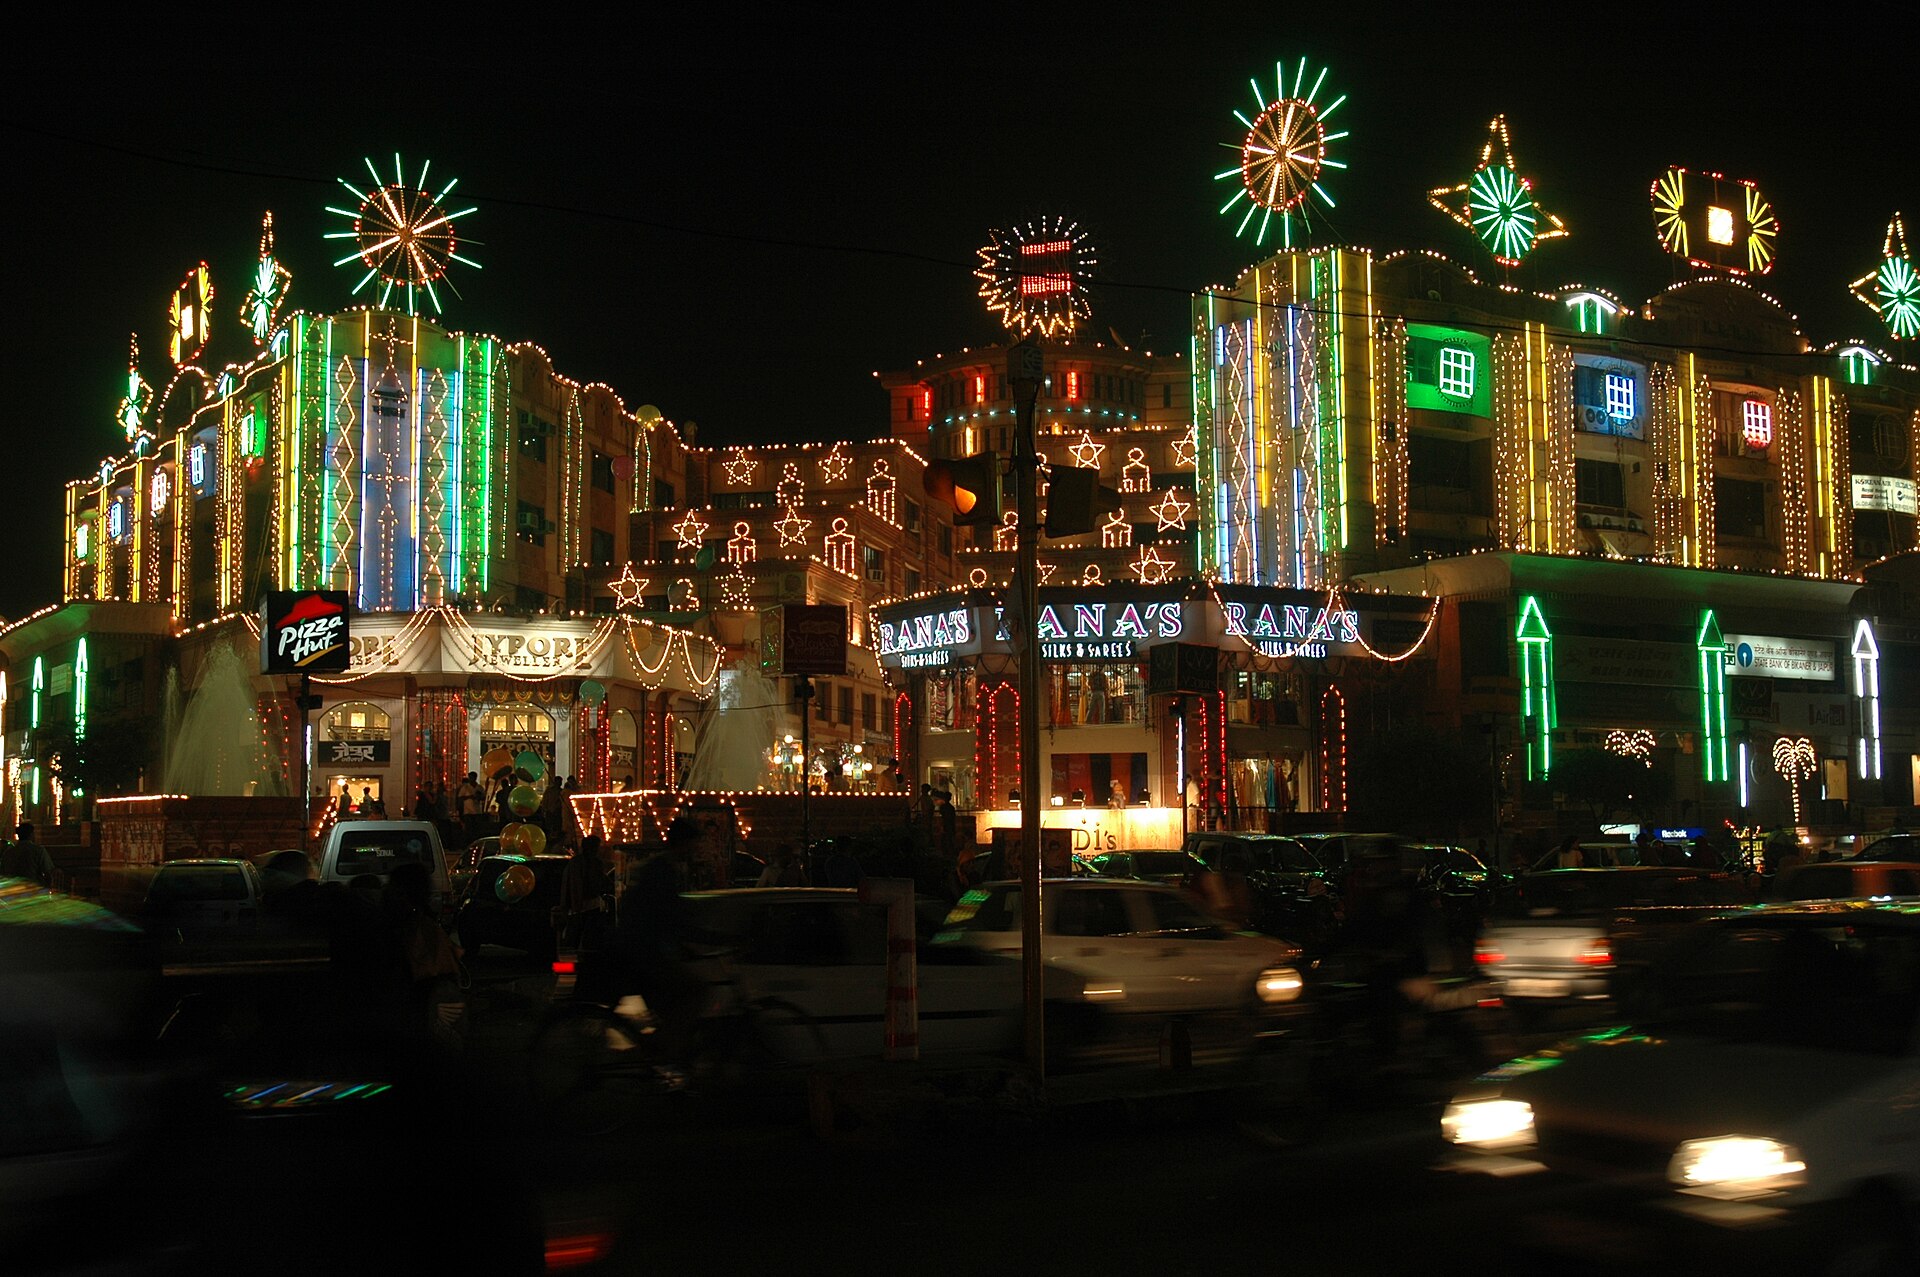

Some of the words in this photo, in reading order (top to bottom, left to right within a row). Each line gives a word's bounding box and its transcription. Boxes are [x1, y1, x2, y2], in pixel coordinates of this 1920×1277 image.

[278, 615, 344, 657] Pizza
[879, 608, 969, 655] RANA'S
[994, 602, 1183, 640] ANA'S
[1226, 602, 1358, 642] RANA'S
[1041, 643, 1072, 658] SILKS
[1076, 643, 1084, 657] &
[1088, 642, 1132, 658] SAREES
[1754, 658, 1768, 668] STATE
[1769, 659, 1783, 669] BANK
[1784, 660, 1790, 669] OF
[1791, 660, 1811, 670] BIKANER
[1661, 829, 1688, 838] Reebok
